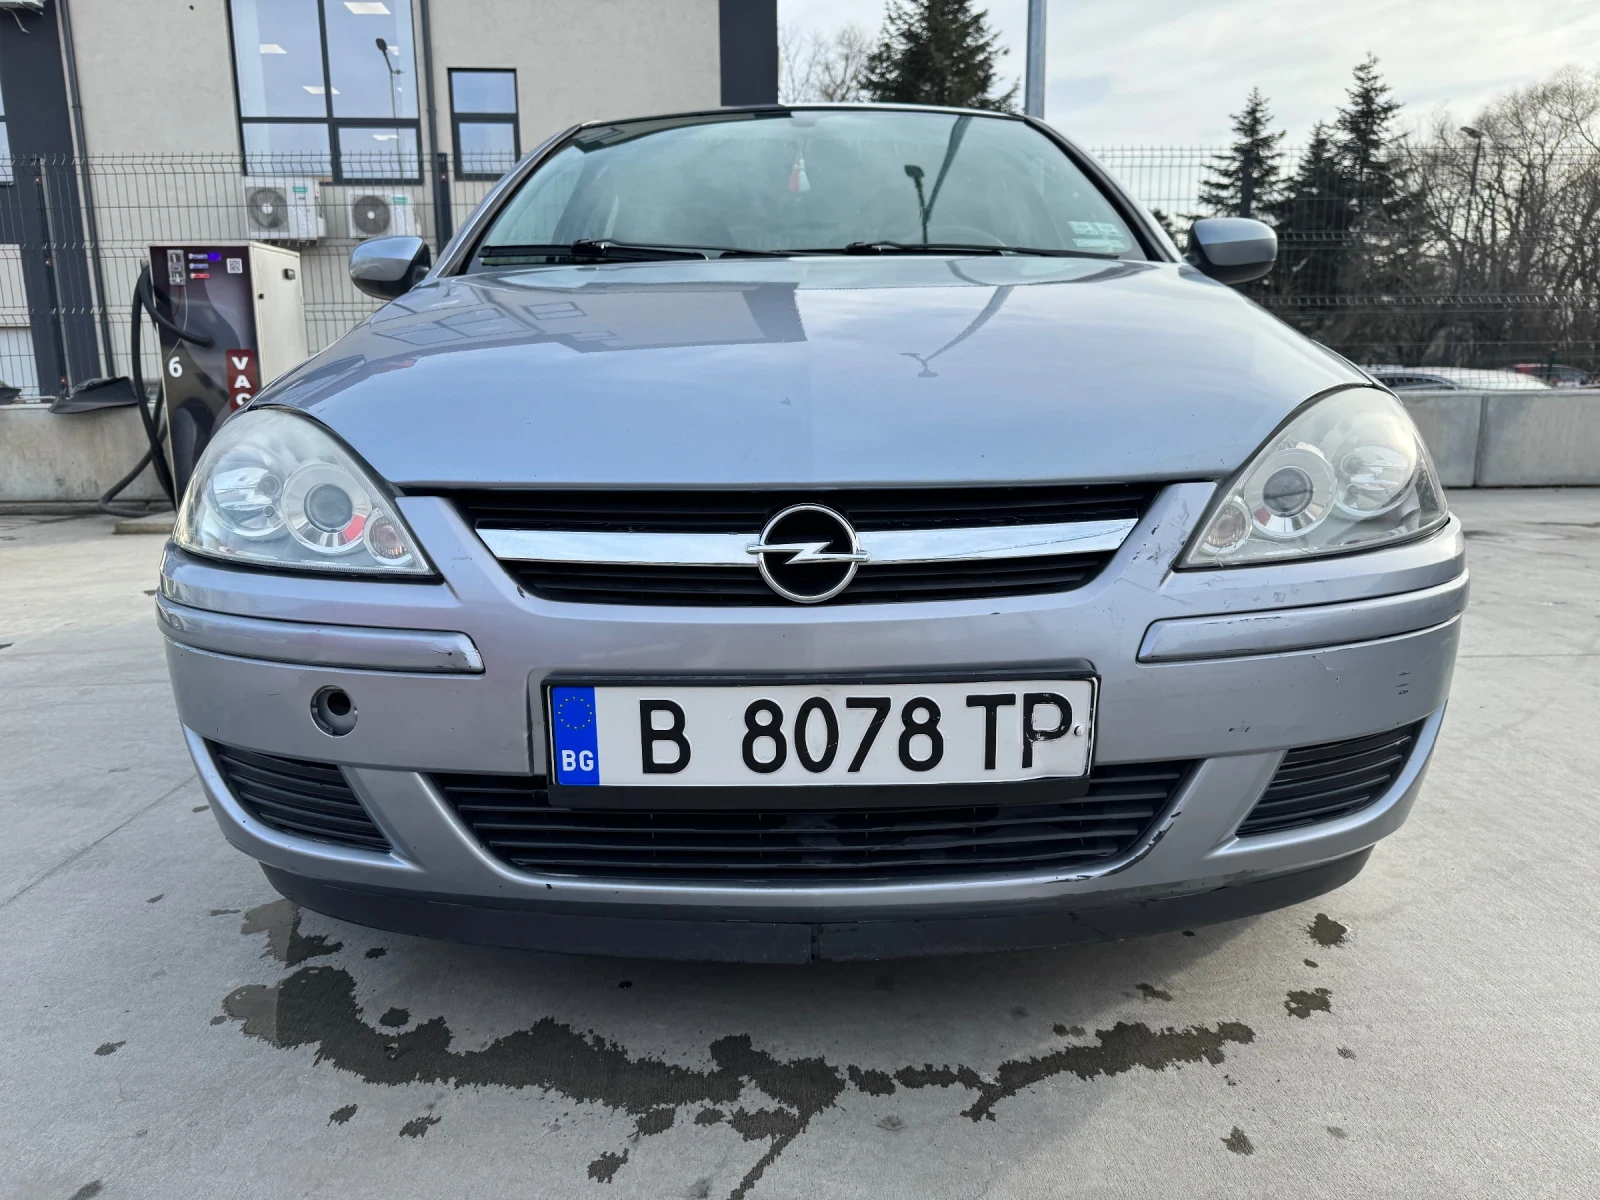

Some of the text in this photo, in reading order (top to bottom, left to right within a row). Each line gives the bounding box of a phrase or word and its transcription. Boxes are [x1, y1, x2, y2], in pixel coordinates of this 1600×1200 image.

[168, 356, 183, 378] 6
[639, 692, 1073, 774] B 8078 TP
[561, 749, 595, 772] BG
